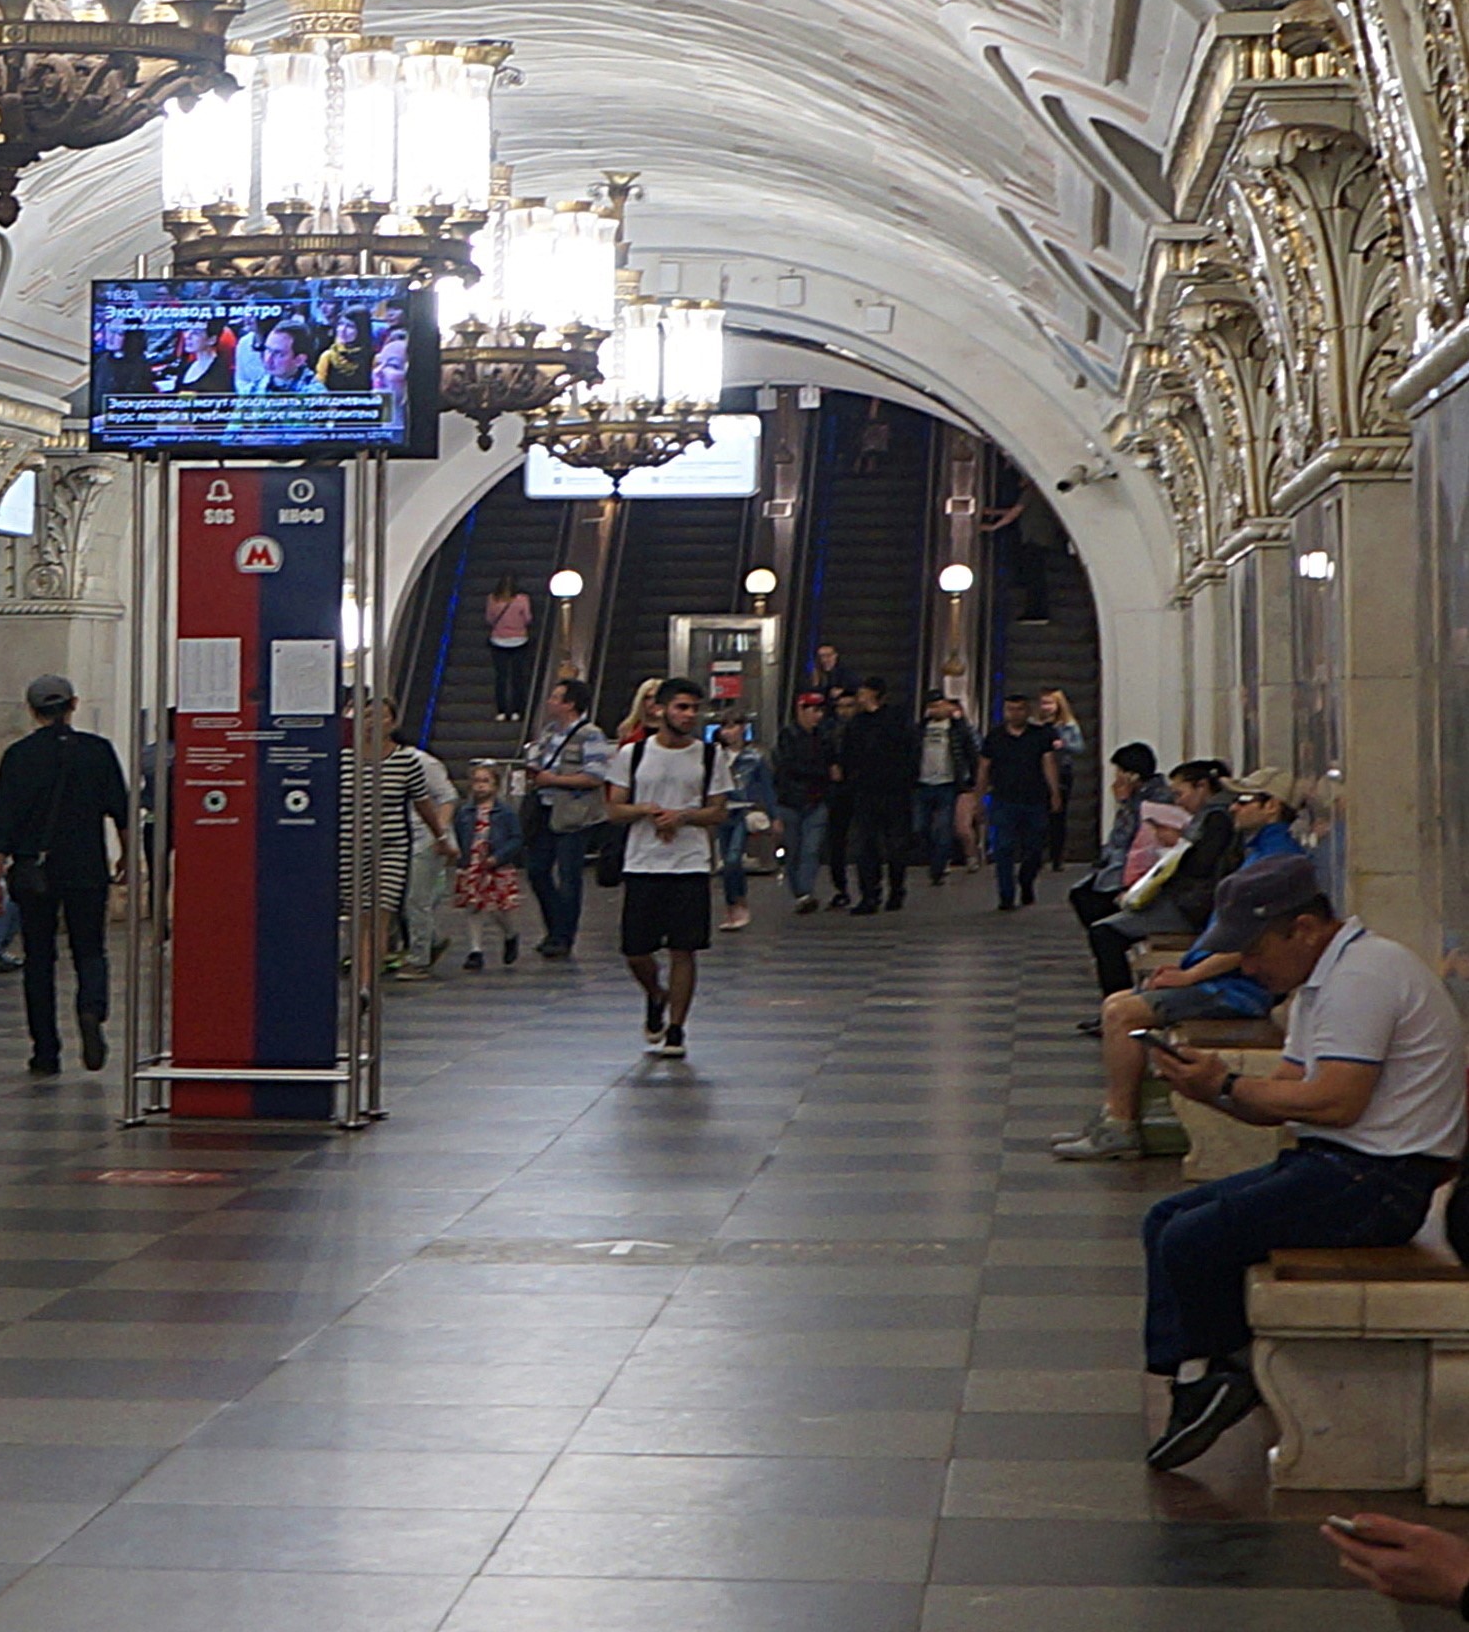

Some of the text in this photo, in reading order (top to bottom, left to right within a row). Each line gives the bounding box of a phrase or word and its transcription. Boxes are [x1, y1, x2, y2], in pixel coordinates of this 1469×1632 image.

[105, 305, 281, 322] Экскурсовод в метро
[204, 508, 235, 524] SOS
[278, 507, 324, 523] ИНФО
